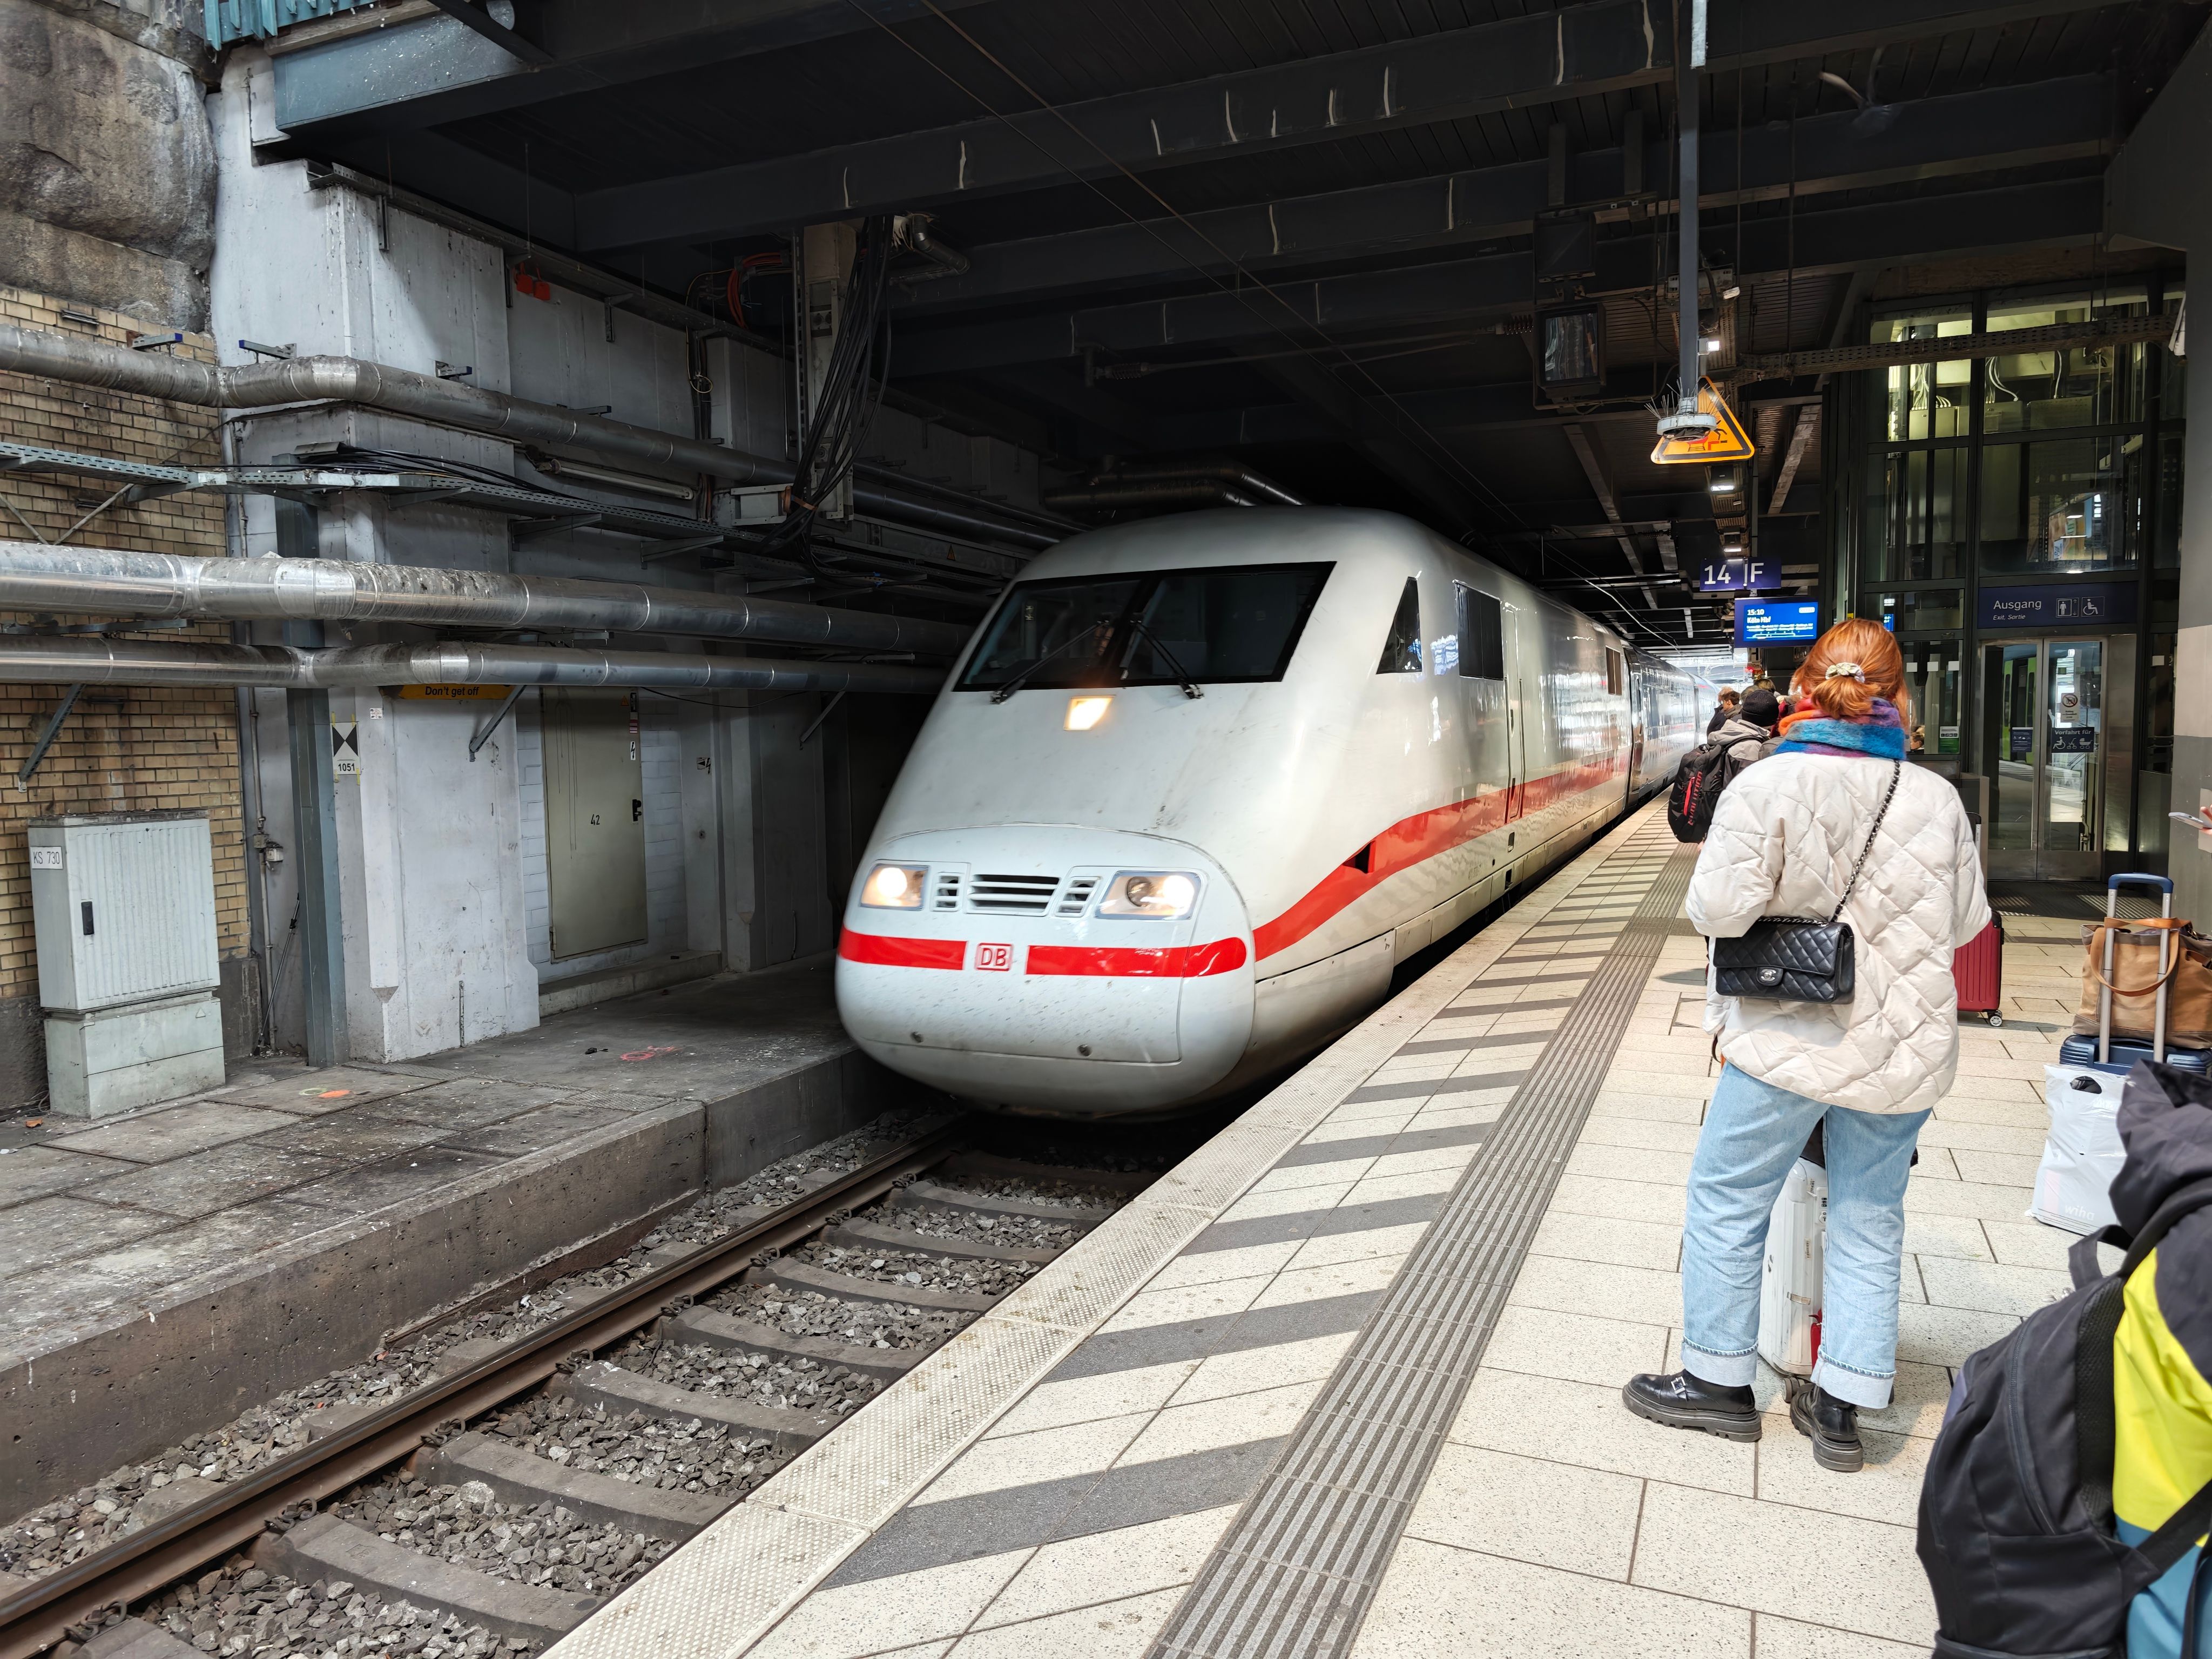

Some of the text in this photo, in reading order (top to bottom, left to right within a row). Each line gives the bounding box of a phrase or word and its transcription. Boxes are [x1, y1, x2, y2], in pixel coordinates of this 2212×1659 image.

[1704, 562, 1764, 585] 14 F
[1993, 600, 2042, 611] Ausgang
[425, 686, 480, 697] Don't get off
[338, 763, 355, 772] 1051
[590, 814, 600, 825] 42
[33, 851, 60, 865] KS 730
[980, 947, 1007, 967] DB
[2065, 1205, 2095, 1221] wiha
